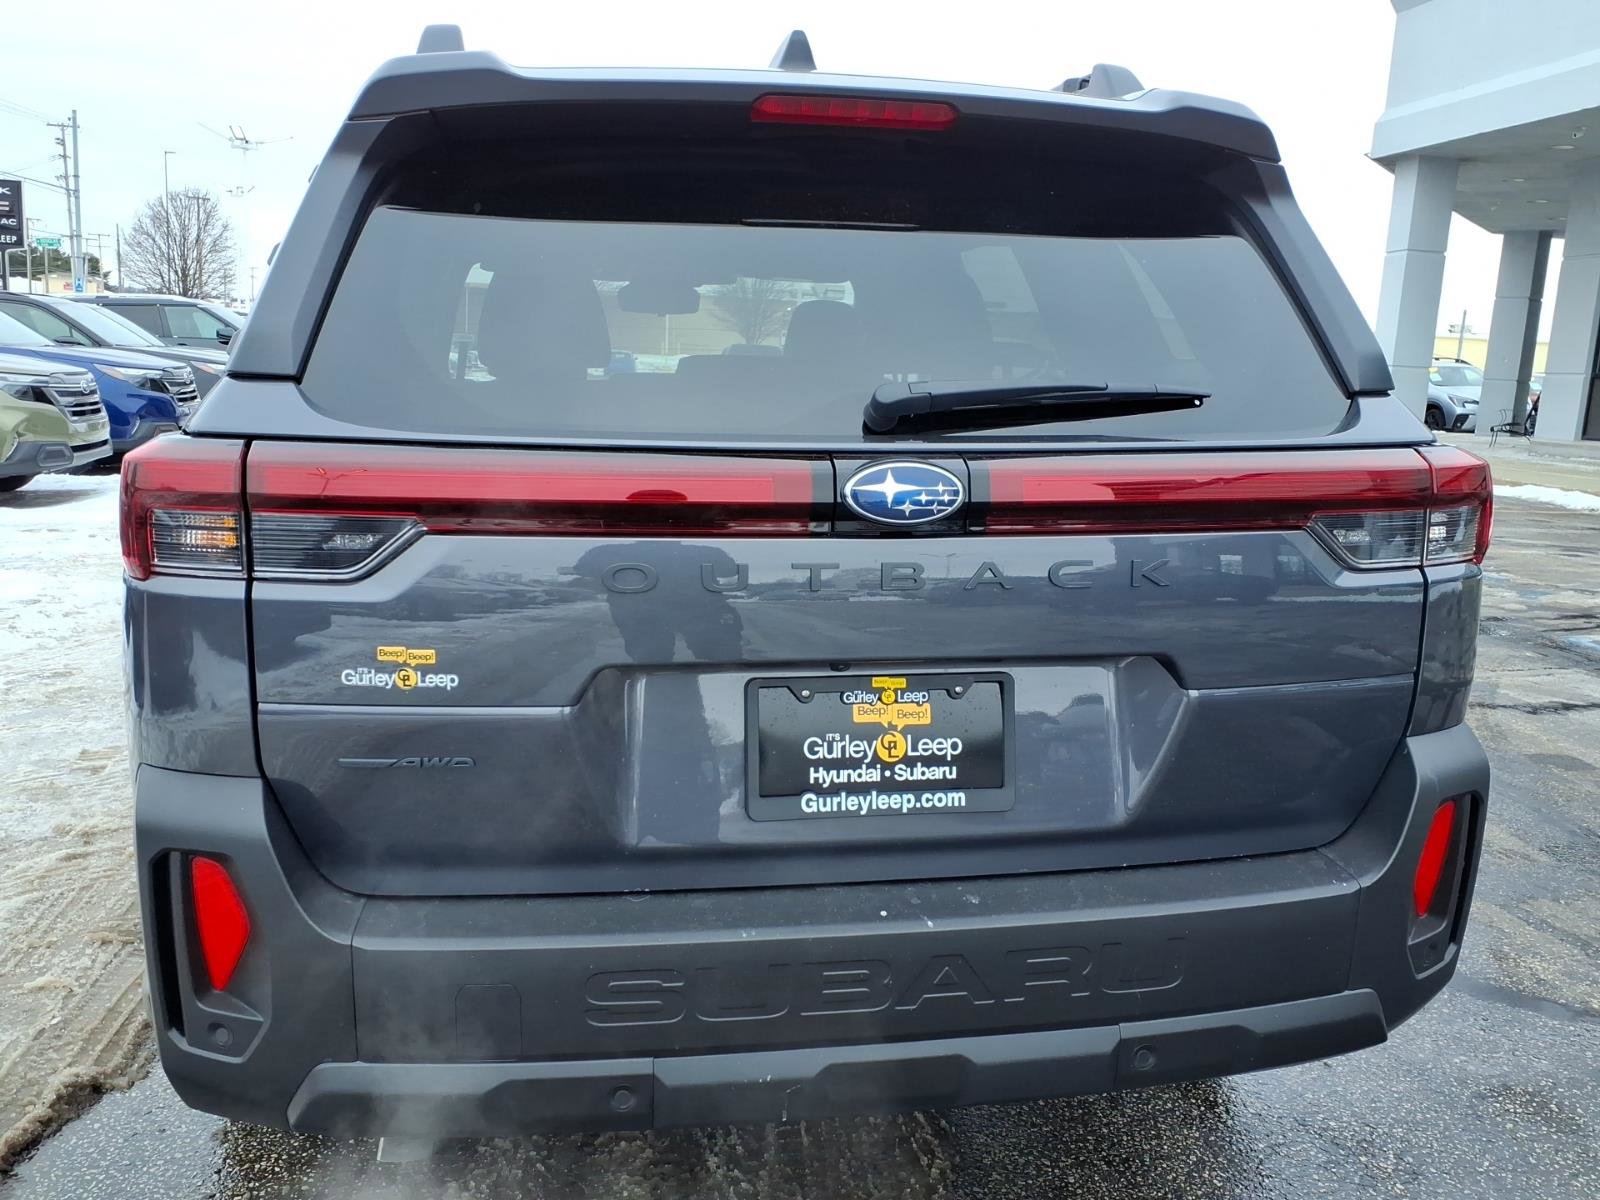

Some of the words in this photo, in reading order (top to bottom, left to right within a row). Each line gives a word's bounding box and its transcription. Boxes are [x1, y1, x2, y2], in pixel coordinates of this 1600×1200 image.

[0, 235, 17, 244] EEP
[601, 559, 1171, 594] OUTBACK
[341, 668, 396, 689] Gurley
[417, 671, 459, 691] Leep
[843, 690, 879, 706] Gurley
[897, 689, 929, 705] Leep
[857, 705, 889, 718] Beep!
[896, 708, 929, 722] Beep!
[803, 734, 877, 763] Gurley
[906, 734, 963, 761] Leep
[390, 756, 477, 768] AWD
[809, 764, 881, 788] Hyundai
[894, 762, 957, 782] Subaru
[800, 790, 967, 815] Gurleyleep.com
[584, 936, 1186, 1027] SUBARU
